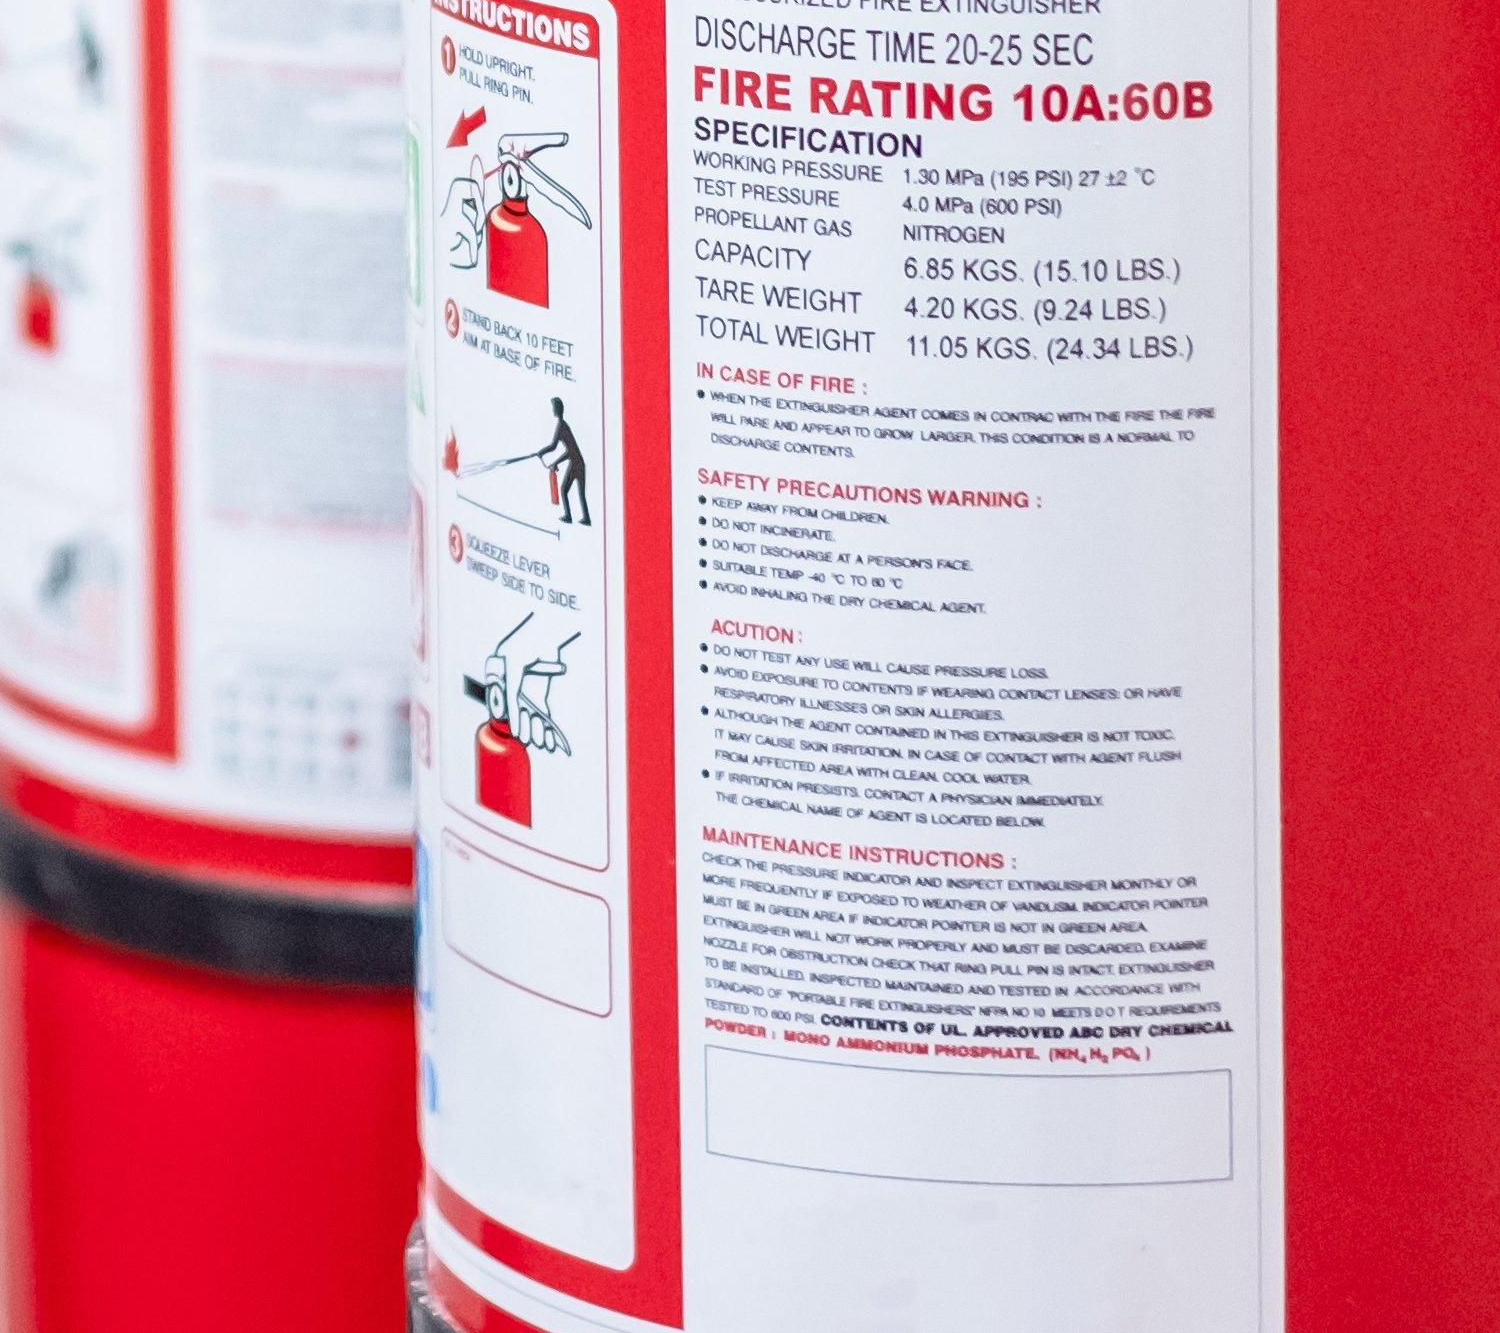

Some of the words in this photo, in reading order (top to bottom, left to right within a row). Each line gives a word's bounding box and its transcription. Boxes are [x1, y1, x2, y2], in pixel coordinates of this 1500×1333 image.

[696, 15, 856, 61] DISCHARGE
[866, 30, 935, 64] TIME
[946, 32, 1022, 66] 20-25
[1033, 33, 1093, 66] SEC
[459, 44, 483, 65] HOLD
[486, 53, 535, 81] UPRIGHT.
[459, 66, 481, 88] PULL
[484, 76, 508, 97] RING
[512, 85, 534, 104] PIN.
[695, 65, 791, 111] FIRE
[810, 76, 992, 122] RATING
[1014, 81, 1212, 123] 10A:60B
[695, 116, 922, 158] SPECIFICATION
[693, 149, 776, 175] WORKING
[783, 159, 883, 183] PRESSURE
[904, 168, 939, 186] 1.30
[946, 168, 984, 187] MPa
[991, 170, 1029, 191] (195
[1035, 169, 1072, 191] PSI)
[1079, 170, 1100, 187] 27
[693, 176, 736, 198] TEST
[742, 182, 839, 208] PRESSURE
[902, 196, 929, 213] 4.0
[935, 196, 974, 214] MPa
[980, 197, 1018, 218] (600
[1025, 197, 1062, 218] PSI)
[695, 205, 808, 234] PROPELLANT
[814, 218, 852, 237] GAS
[904, 224, 1004, 244] NITROGEN
[695, 238, 811, 271] CAPACITY
[904, 256, 954, 281] 6.85
[963, 258, 1023, 283] KGS.
[1034, 259, 1108, 288] (15.10
[1117, 257, 1180, 284] LBS.)
[695, 275, 754, 305] TARE
[762, 284, 862, 314] WEIGHT
[904, 296, 954, 320] 4.20
[964, 297, 1024, 321] KGS.
[1034, 299, 1093, 326] (9.24
[1102, 297, 1166, 324] LBS.)
[462, 307, 491, 331] STAND
[494, 321, 522, 343] BACK
[527, 333, 538, 348] 10
[542, 336, 574, 357] FEET
[696, 314, 768, 345] TOTAL
[775, 324, 876, 353] WEIGHT
[907, 335, 967, 359] 11.05
[977, 336, 1036, 360] KGS.
[1047, 337, 1120, 366] (24.34
[1130, 335, 1193, 362] LBS.)
[697, 362, 713, 379] IN
[720, 365, 771, 387] CASE
[778, 371, 803, 389] OF
[811, 375, 855, 395] FIRE
[698, 467, 770, 492] SAFETY
[777, 477, 922, 505] PRECAUTIONS
[927, 489, 1029, 509] WARNING
[711, 618, 793, 644] ACUTION
[703, 825, 841, 860] MAINTENANCE
[850, 845, 1004, 870] INSTRUCTIONS
